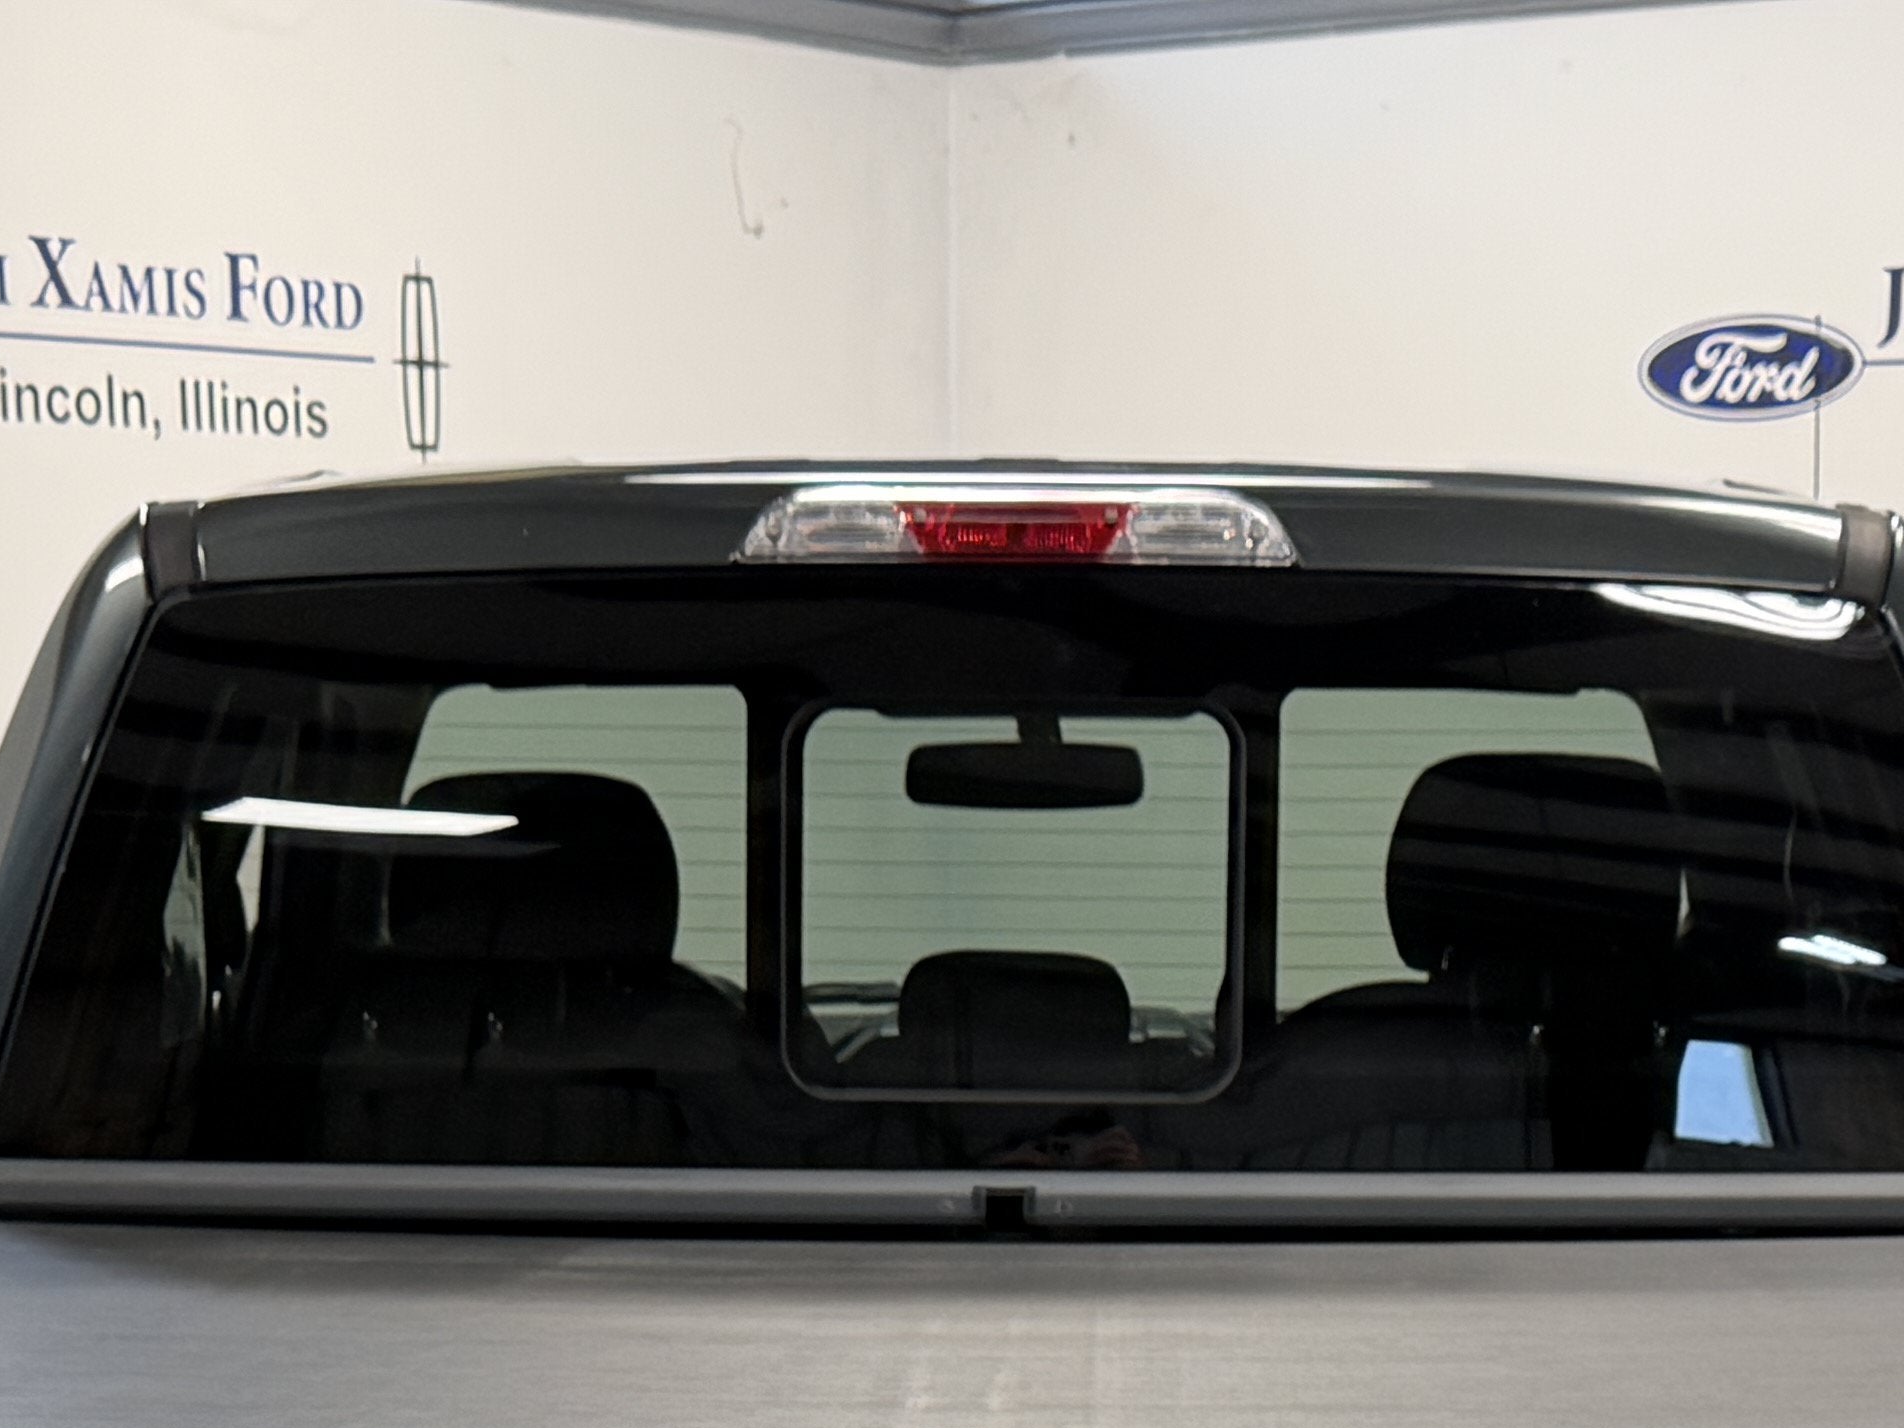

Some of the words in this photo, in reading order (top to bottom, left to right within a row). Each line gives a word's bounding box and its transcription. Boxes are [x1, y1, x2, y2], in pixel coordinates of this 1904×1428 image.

[27, 234, 208, 320] XAMIS
[223, 250, 365, 331] FORD
[1676, 323, 1822, 407] Ford
[178, 377, 330, 440] Illinois
